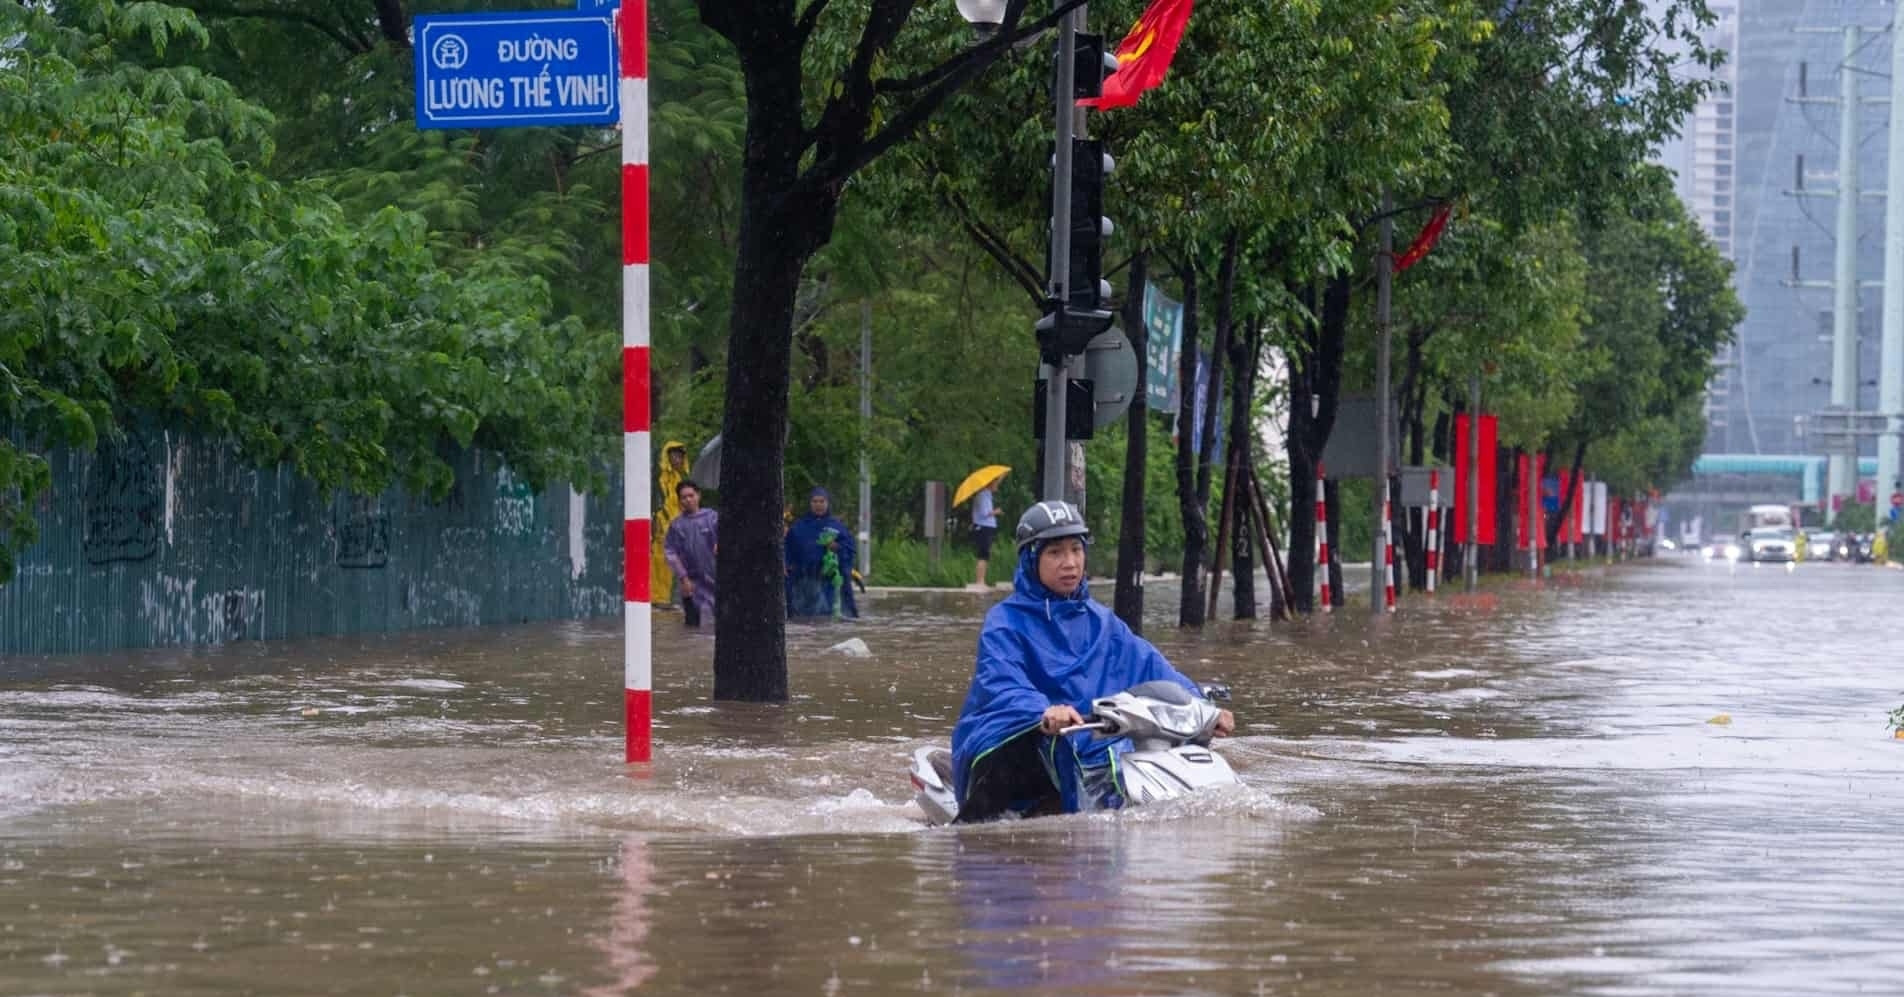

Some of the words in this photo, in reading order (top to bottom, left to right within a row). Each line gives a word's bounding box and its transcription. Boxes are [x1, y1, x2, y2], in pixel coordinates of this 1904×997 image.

[498, 34, 578, 62] ĐƯỜNG
[429, 77, 504, 110] LƯƠNG
[510, 64, 552, 108] THẾ
[556, 75, 608, 107] VINH
